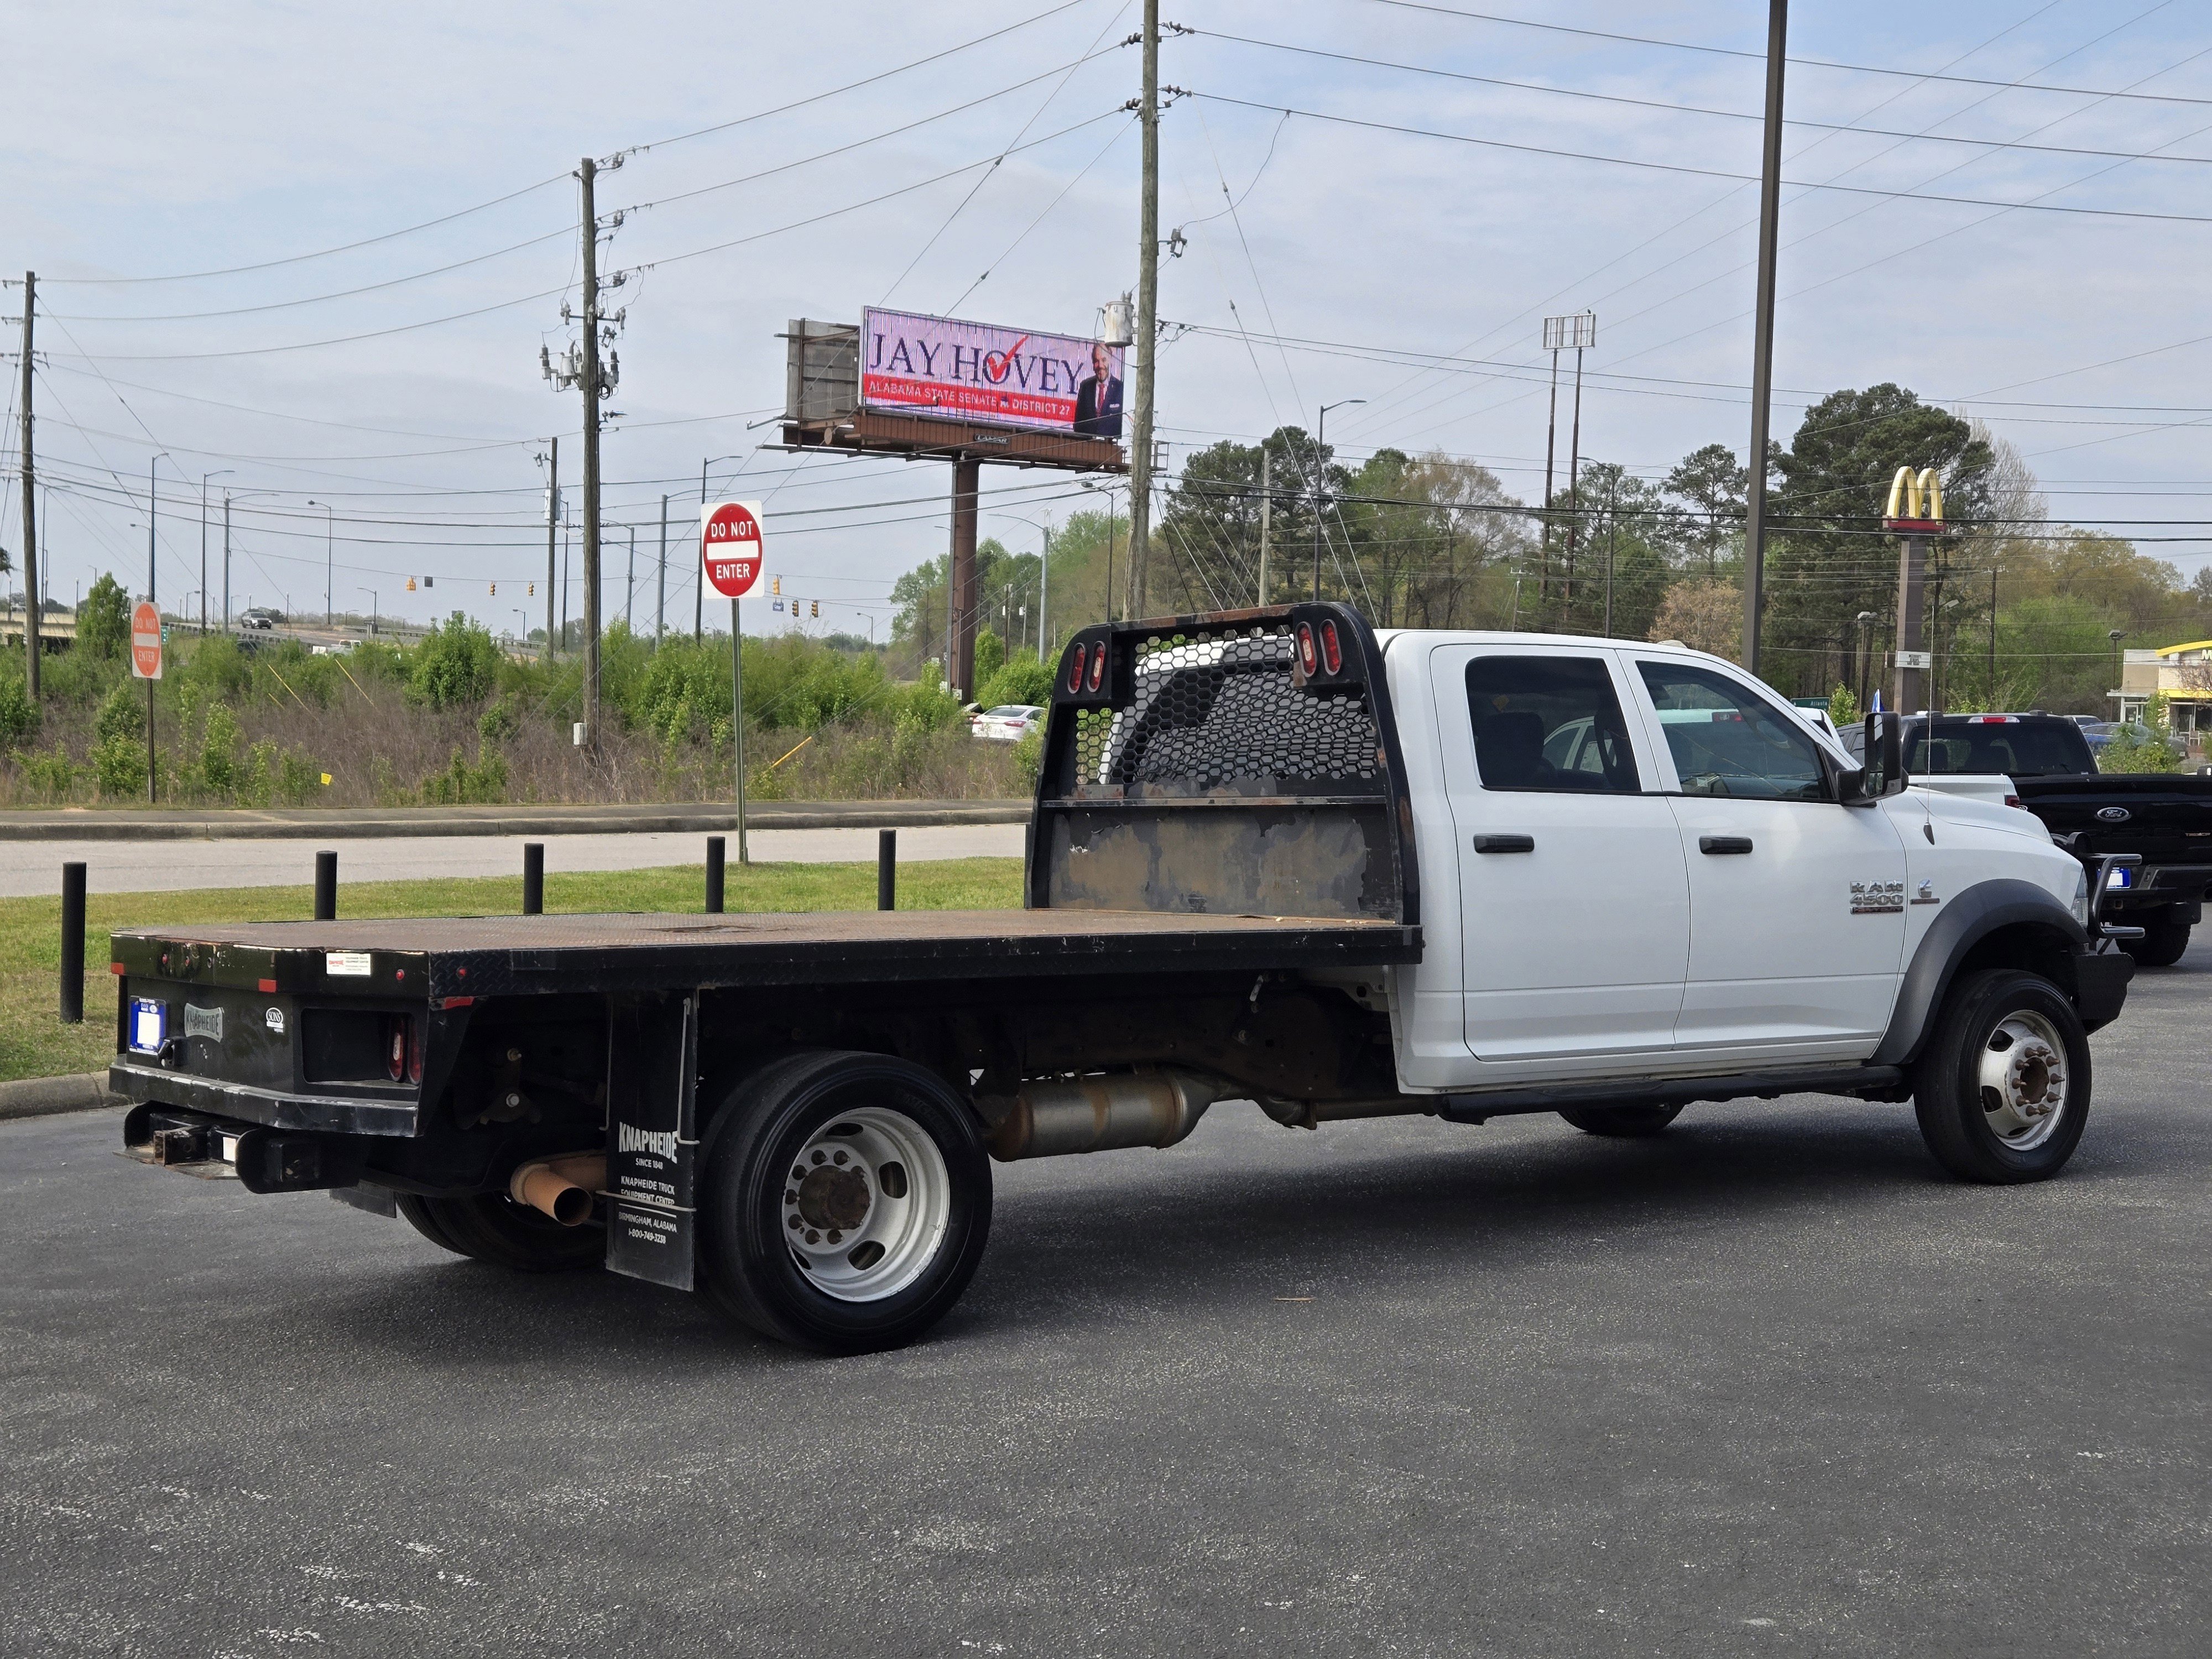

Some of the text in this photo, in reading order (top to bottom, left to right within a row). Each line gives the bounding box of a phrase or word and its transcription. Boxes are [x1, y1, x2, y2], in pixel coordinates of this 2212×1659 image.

[870, 333, 1084, 395] JAY HOVEY
[869, 380, 1071, 415] ALABAMA STATE SENATE DISTRICT 27
[711, 520, 753, 538] DO NOT
[716, 563, 750, 579] ENTER
[135, 617, 156, 629] DO NOT
[138, 650, 155, 662] ENTER
[1850, 880, 1903, 893] RAM
[1850, 893, 1903, 906] 4500
[618, 1121, 677, 1164] KNAPHEIDE
[635, 1157, 652, 1168] SINCE
[621, 1175, 675, 1196] KNAPHEIDE TRUCK
[653, 1219, 677, 1233] ALABAMA
